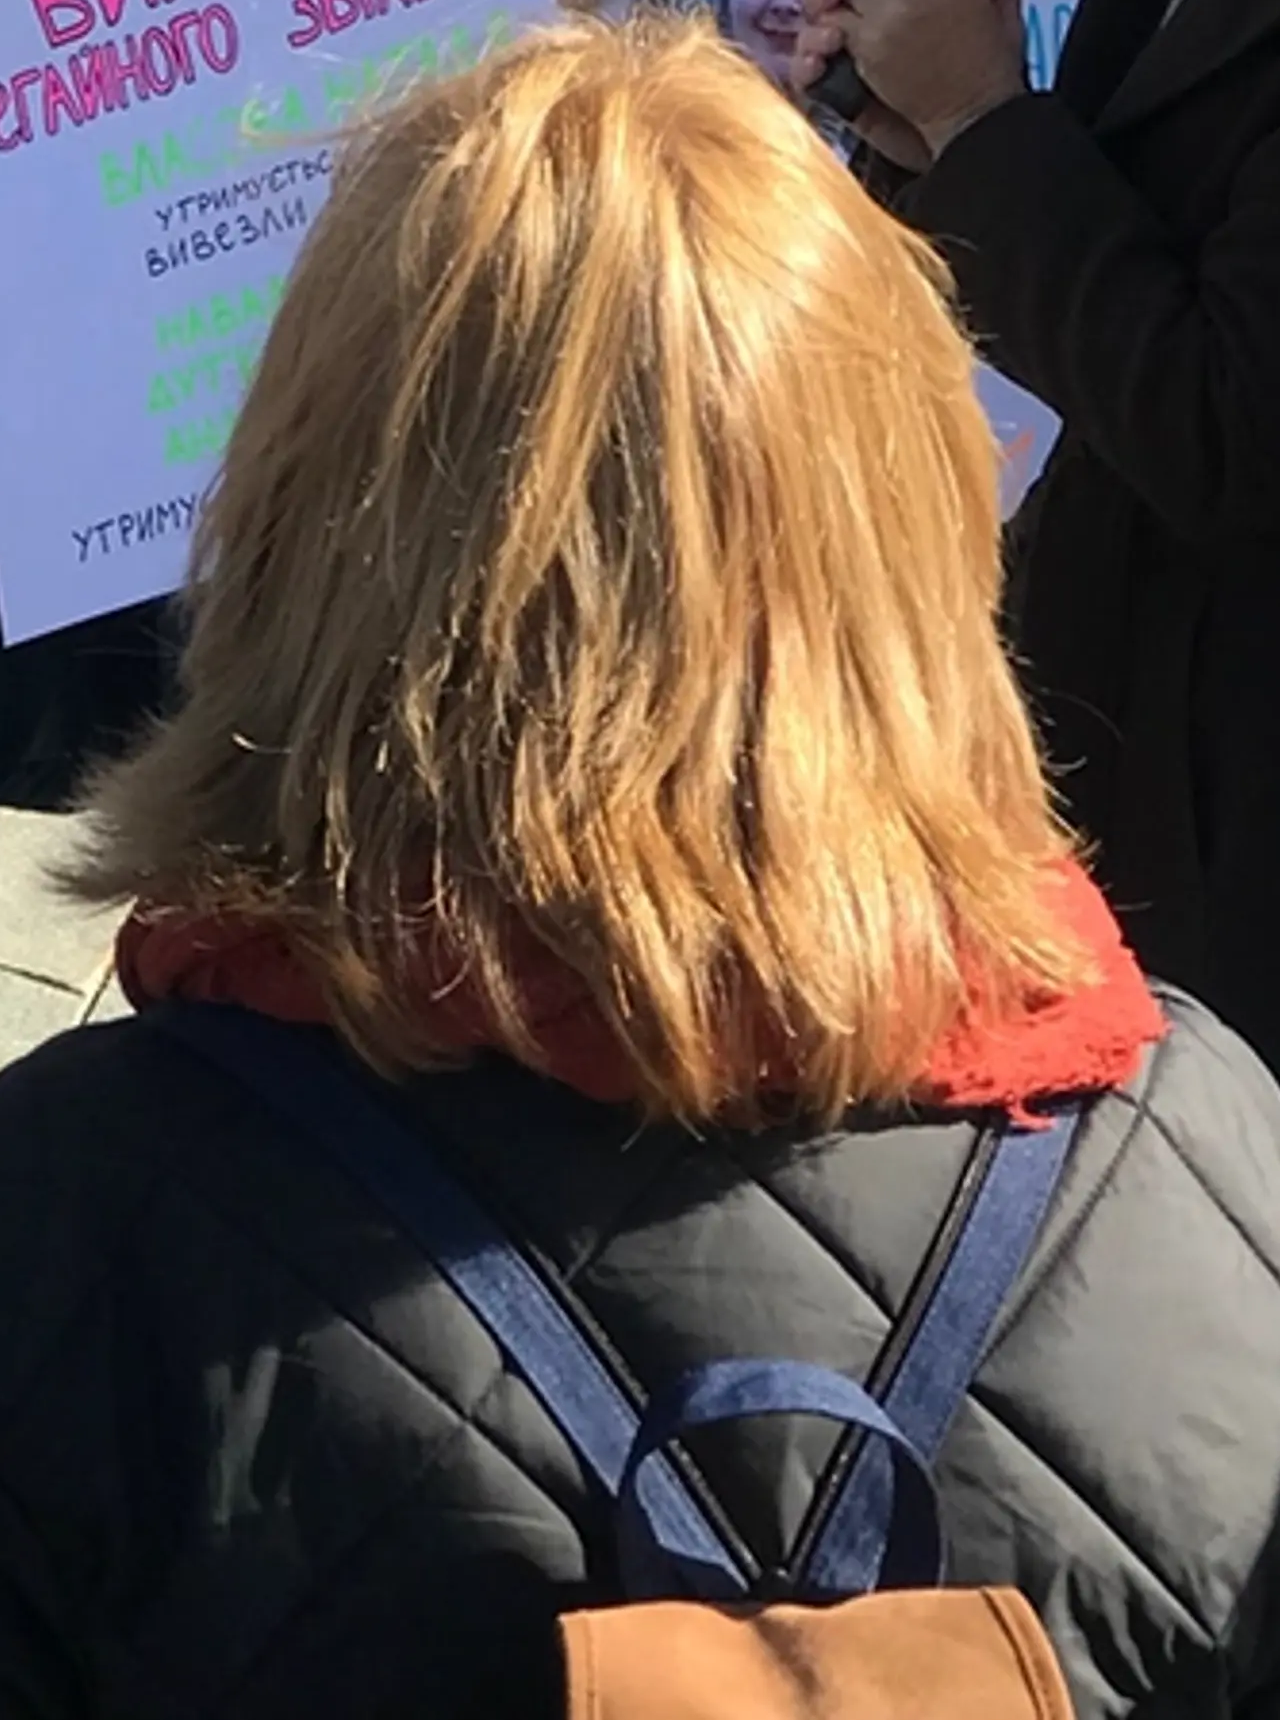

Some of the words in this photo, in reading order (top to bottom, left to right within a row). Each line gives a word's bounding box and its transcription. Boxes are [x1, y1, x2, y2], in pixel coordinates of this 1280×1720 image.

[154, 149, 333, 231] УТРИМУЄТЬС
[145, 195, 308, 278] ВИВЕЗЛИ
[71, 492, 198, 563] УТРИМУ
